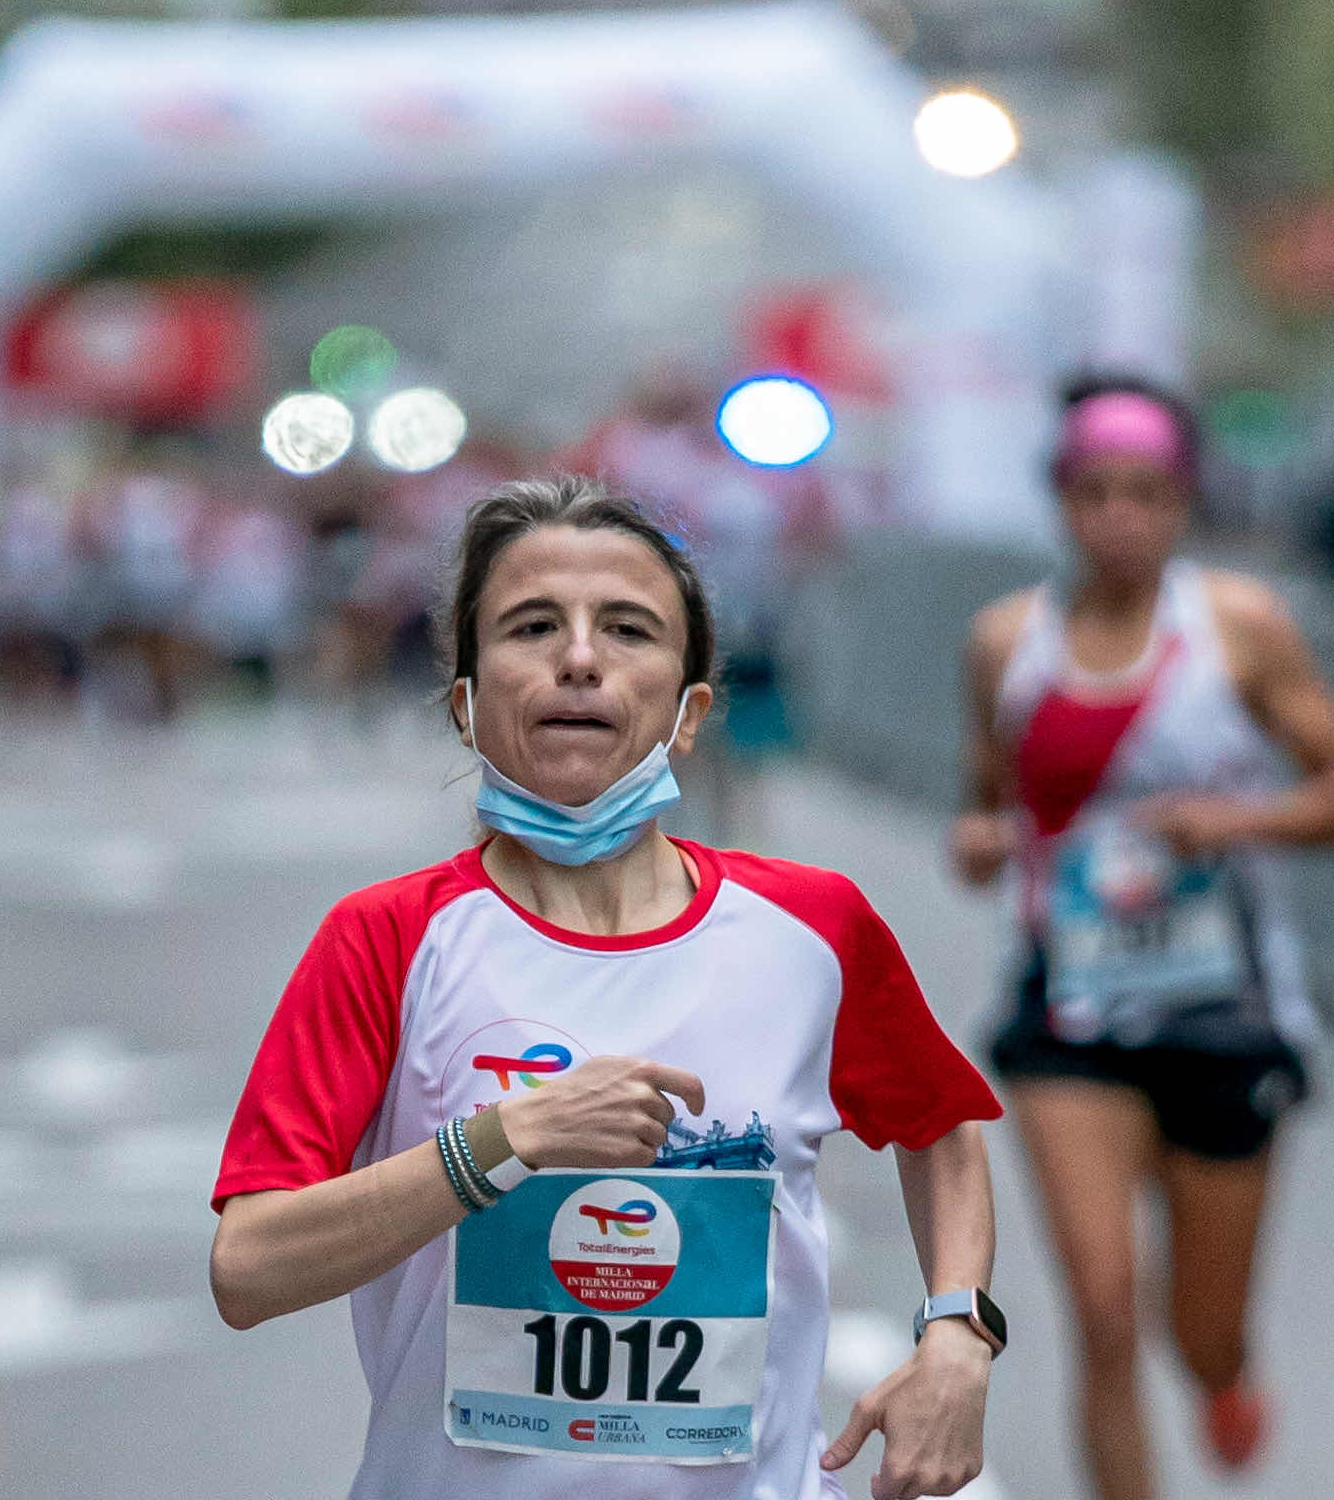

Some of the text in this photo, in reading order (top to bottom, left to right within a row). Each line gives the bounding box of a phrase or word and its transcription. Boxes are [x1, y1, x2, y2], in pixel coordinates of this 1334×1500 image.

[578, 1242, 656, 1257] TotalEnergies
[595, 1267, 633, 1278] MILLA
[580, 1289, 646, 1301] DE MADRID
[524, 1314, 704, 1404] 1012
[481, 1412, 550, 1433] MADRID
[598, 1420, 640, 1432] MILLA
